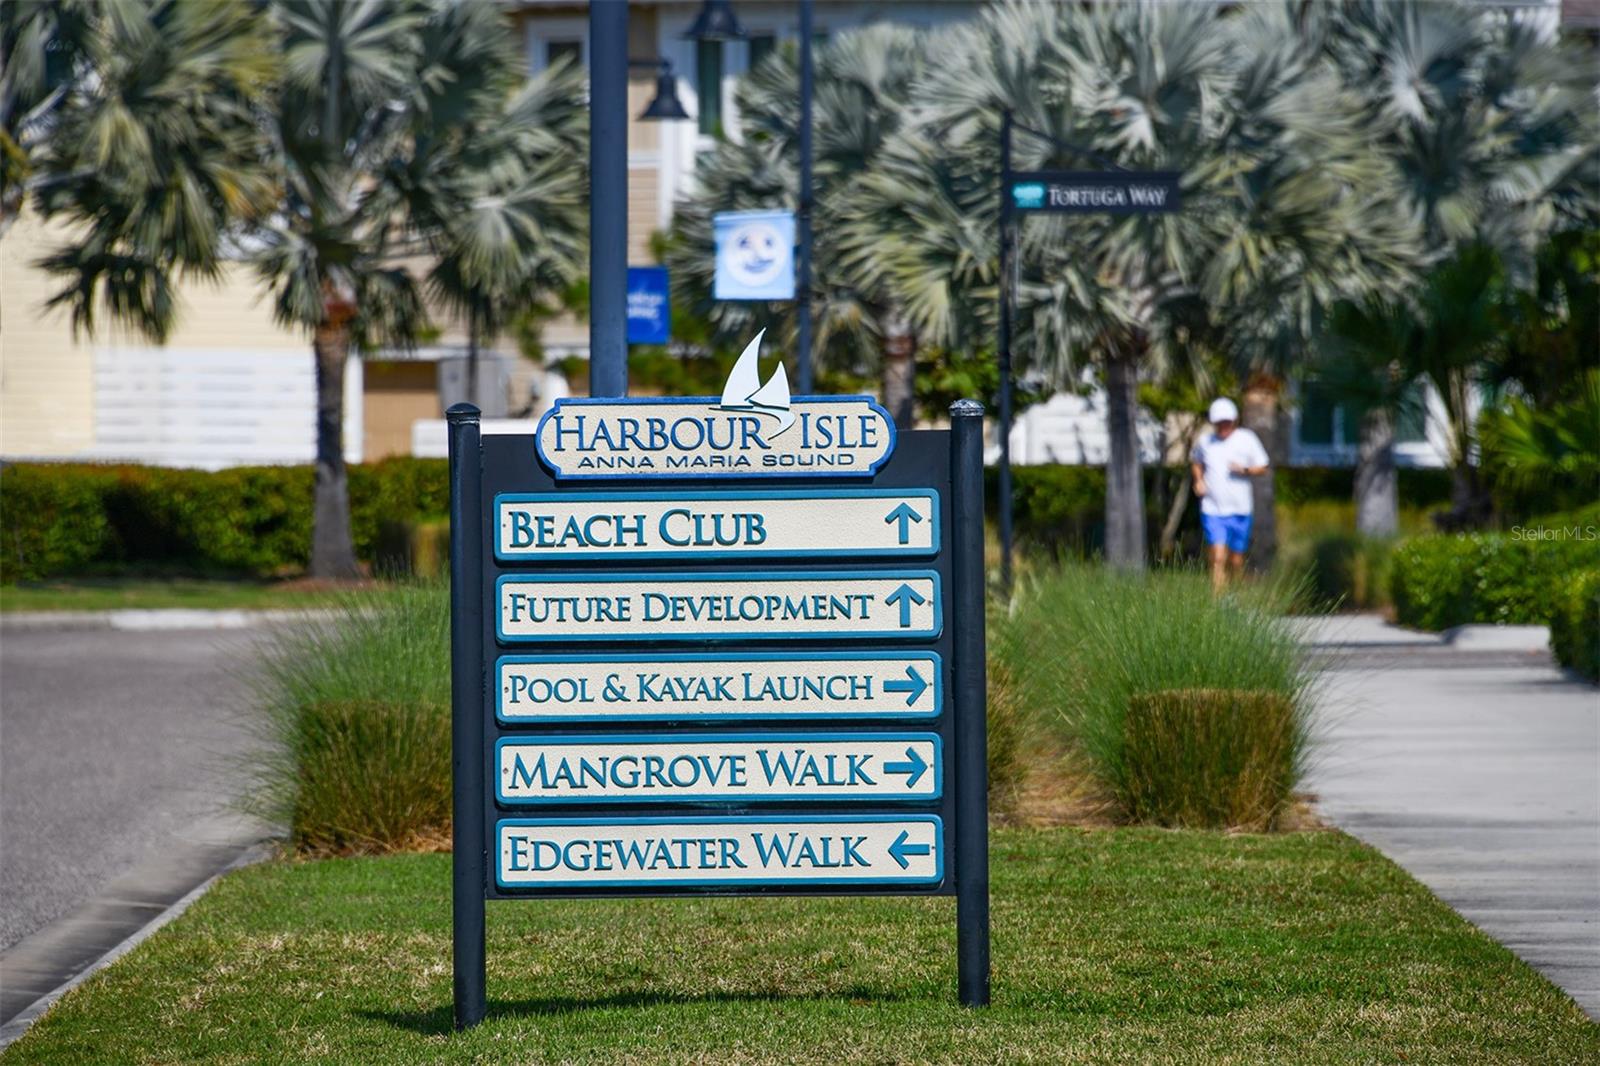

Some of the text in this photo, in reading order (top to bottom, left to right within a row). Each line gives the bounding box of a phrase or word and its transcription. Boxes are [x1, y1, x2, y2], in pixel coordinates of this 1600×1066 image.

[1129, 185, 1168, 206] WAY
[553, 412, 879, 452] HARBOUR ISLE
[578, 453, 855, 469] ANNA MARIA SOUND
[508, 509, 768, 548] BEACH CLUB
[508, 591, 875, 623] FUTURE DEVELOPMENT
[508, 672, 874, 704] POOL & KAYAK LAUNCH
[508, 748, 878, 790] MANGROVE WALK
[508, 831, 872, 872] EDGEWATER WALK
